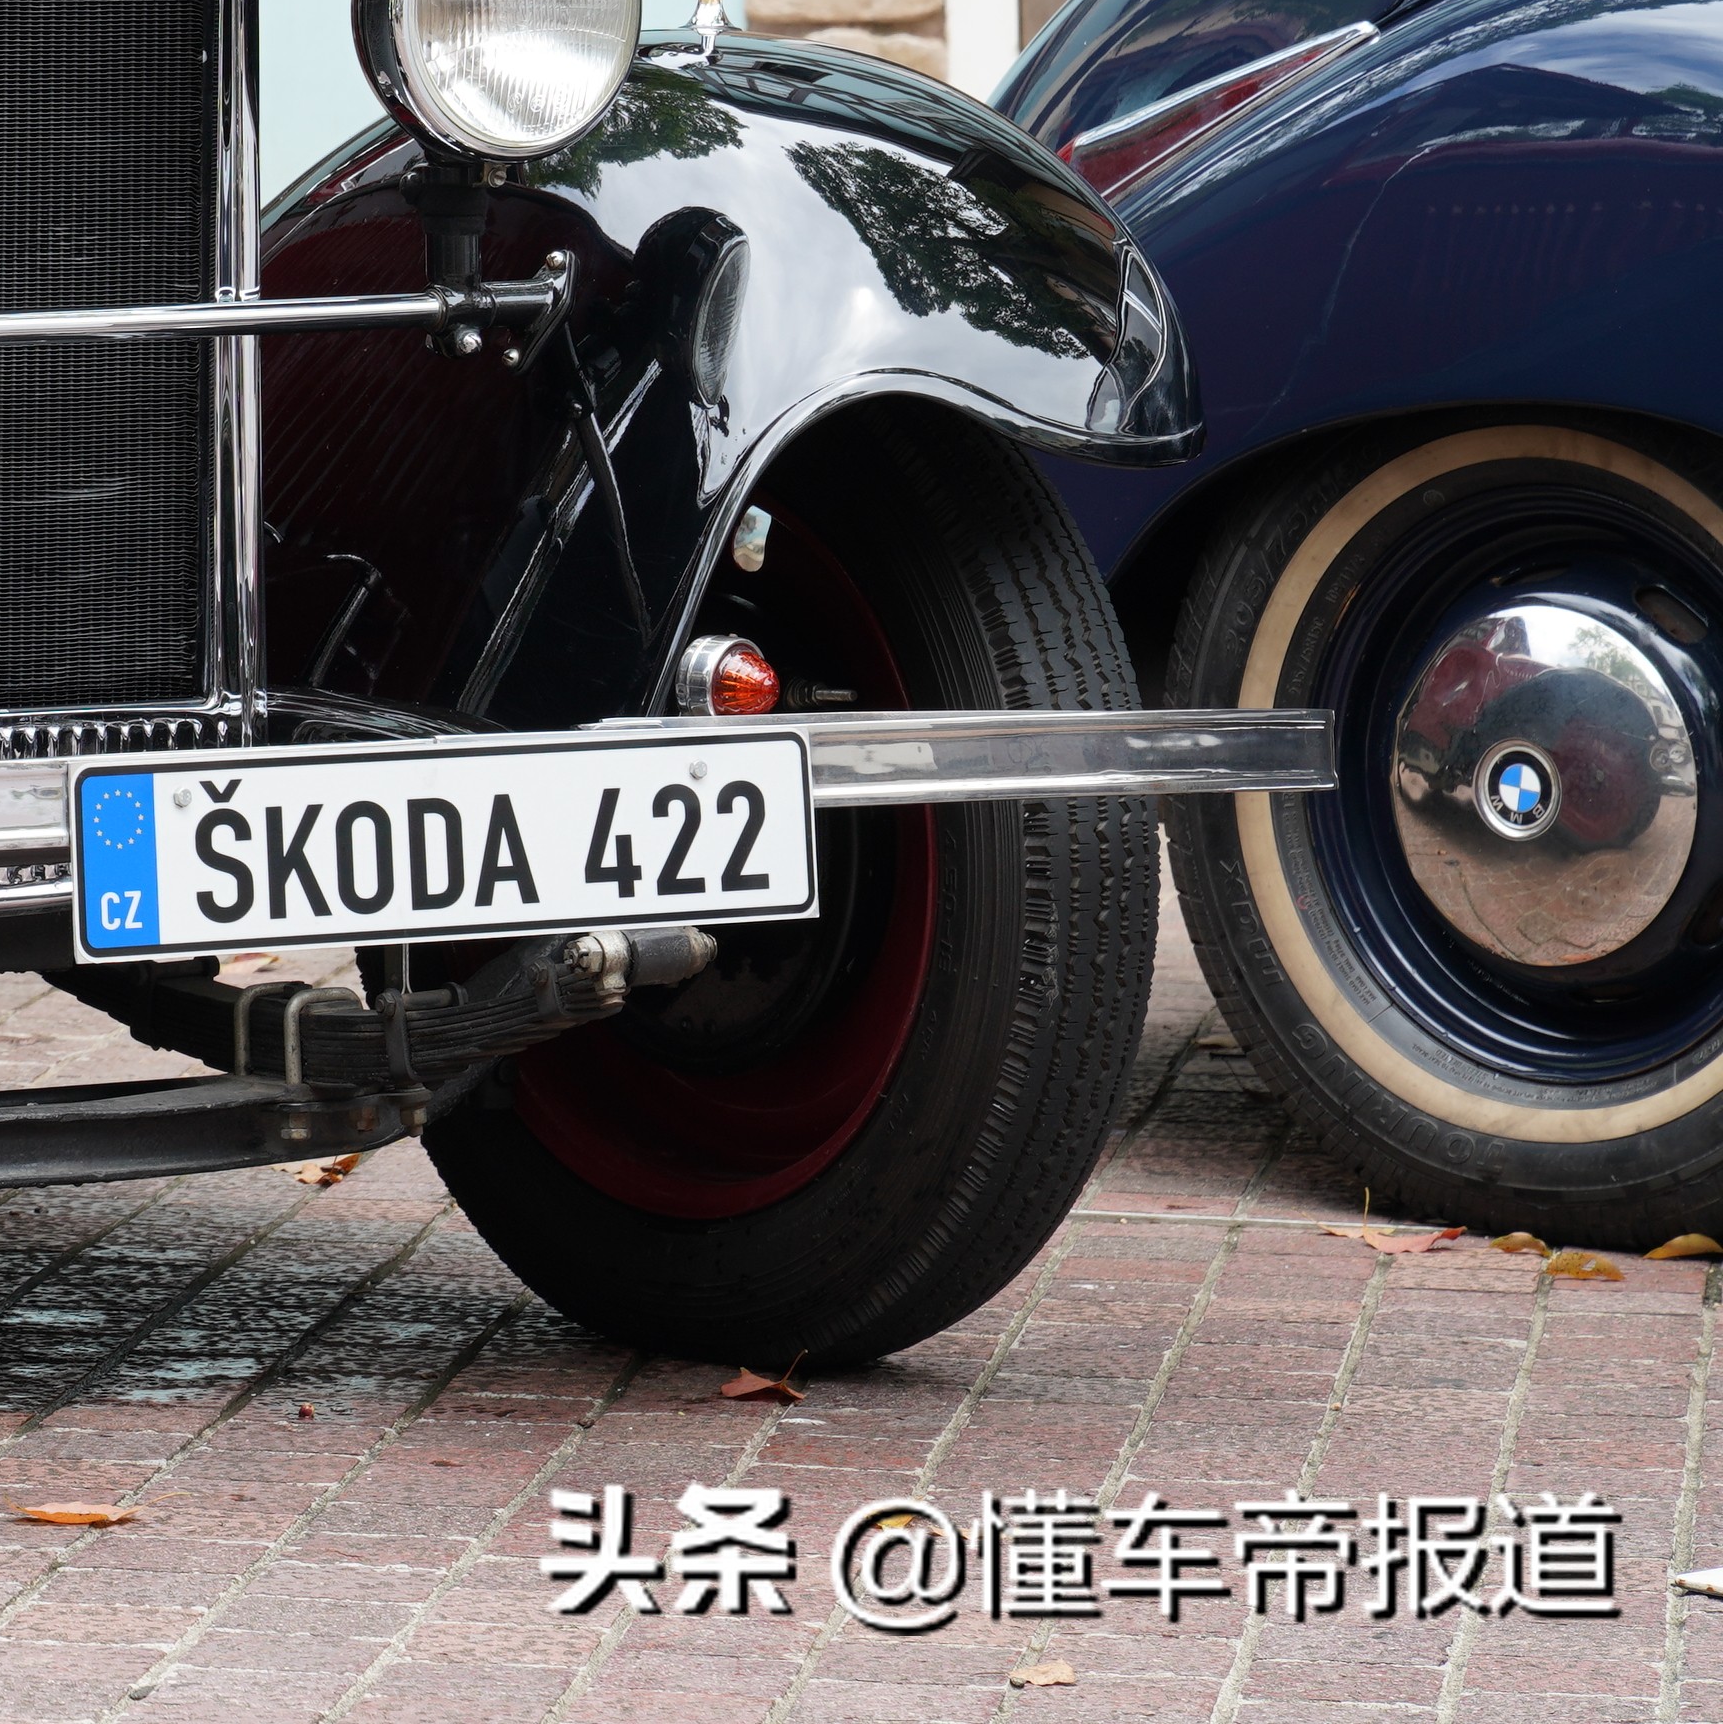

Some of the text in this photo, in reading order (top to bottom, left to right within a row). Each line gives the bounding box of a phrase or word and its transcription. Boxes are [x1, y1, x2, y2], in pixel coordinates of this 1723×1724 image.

[194, 778, 770, 924] ŠKODA 422
[1490, 794, 1546, 824] BMW
[100, 889, 143, 931] CZ
[1292, 1022, 1505, 1167] TOURING
